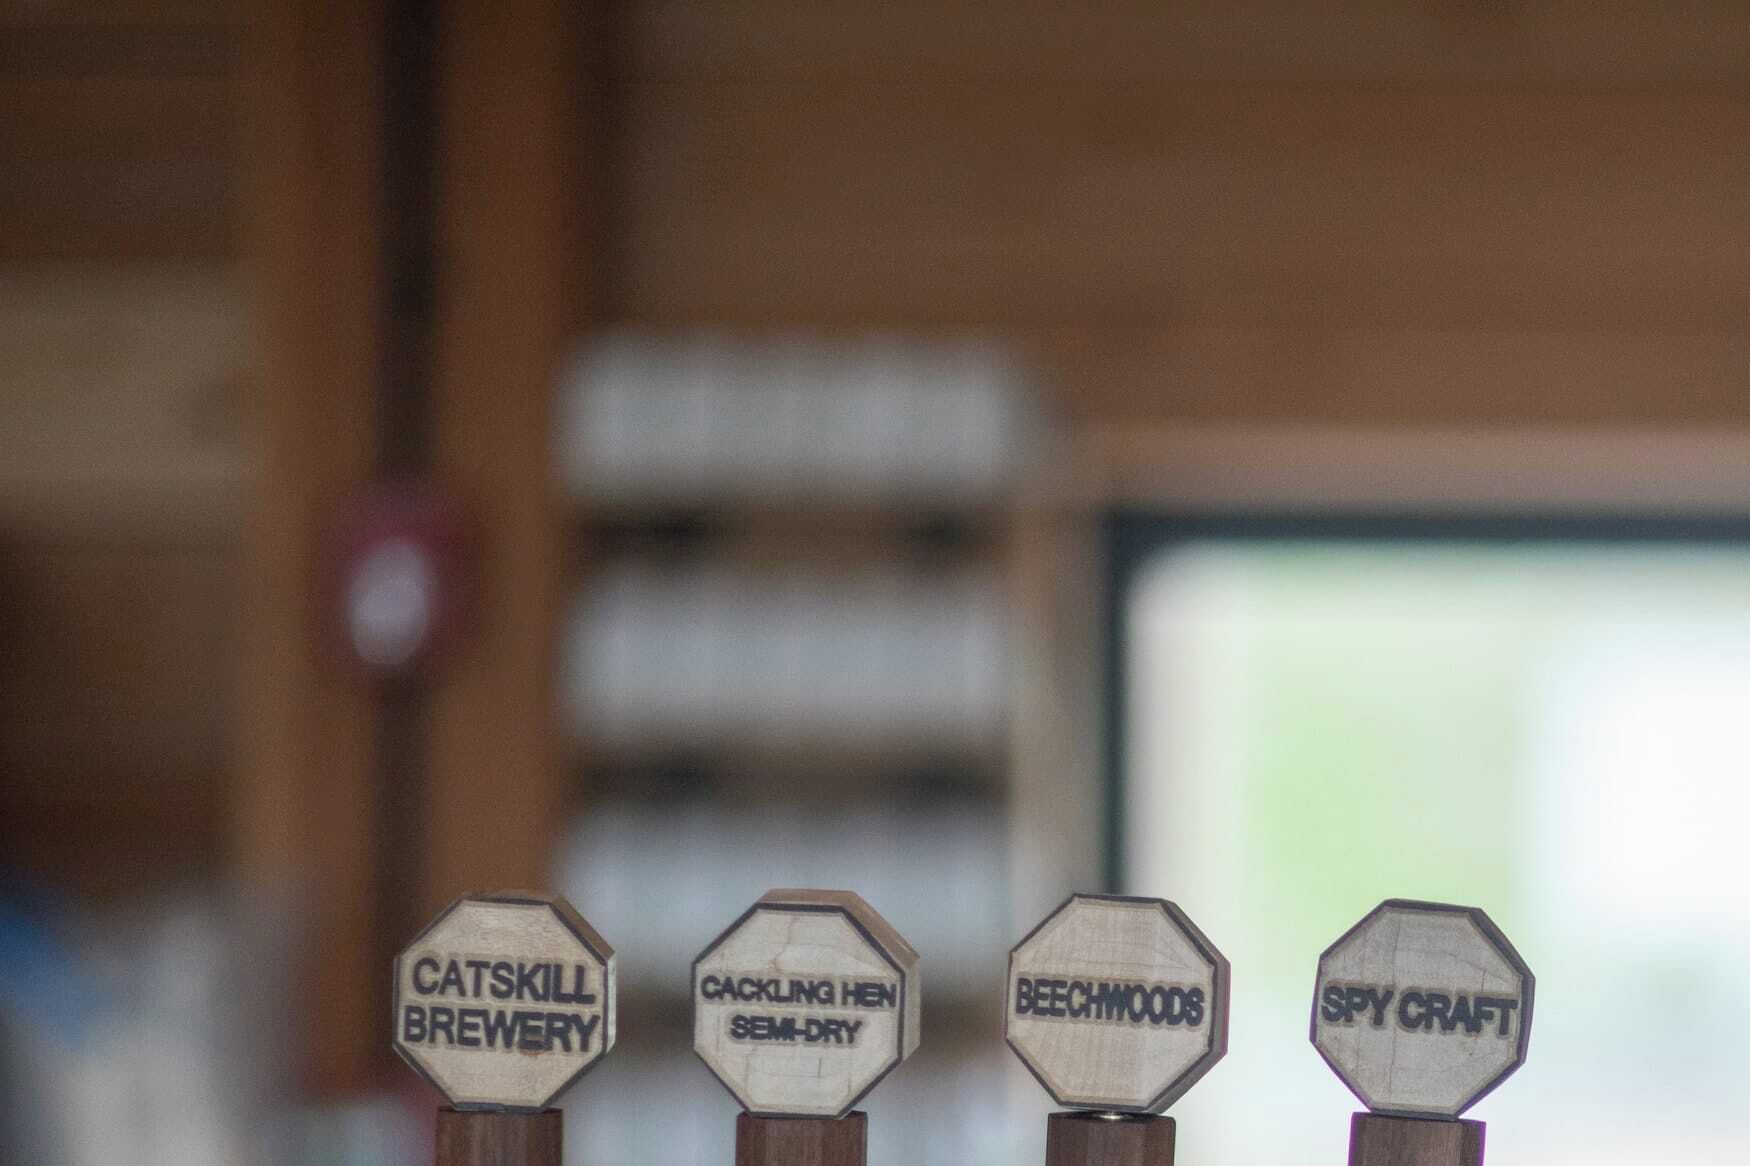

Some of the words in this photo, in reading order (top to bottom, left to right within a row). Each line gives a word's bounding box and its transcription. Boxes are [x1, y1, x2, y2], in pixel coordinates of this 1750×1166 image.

[412, 957, 597, 1005] CATSKILL
[701, 975, 835, 1005] CACKLING
[841, 982, 897, 1008] HEN
[1015, 977, 1205, 1027] BEECHWOODS
[404, 1005, 601, 1052] BREWERY
[730, 1014, 863, 1044] SEMI-DRY
[1321, 986, 1394, 1026] SPY
[1399, 991, 1519, 1036] CRAFT
